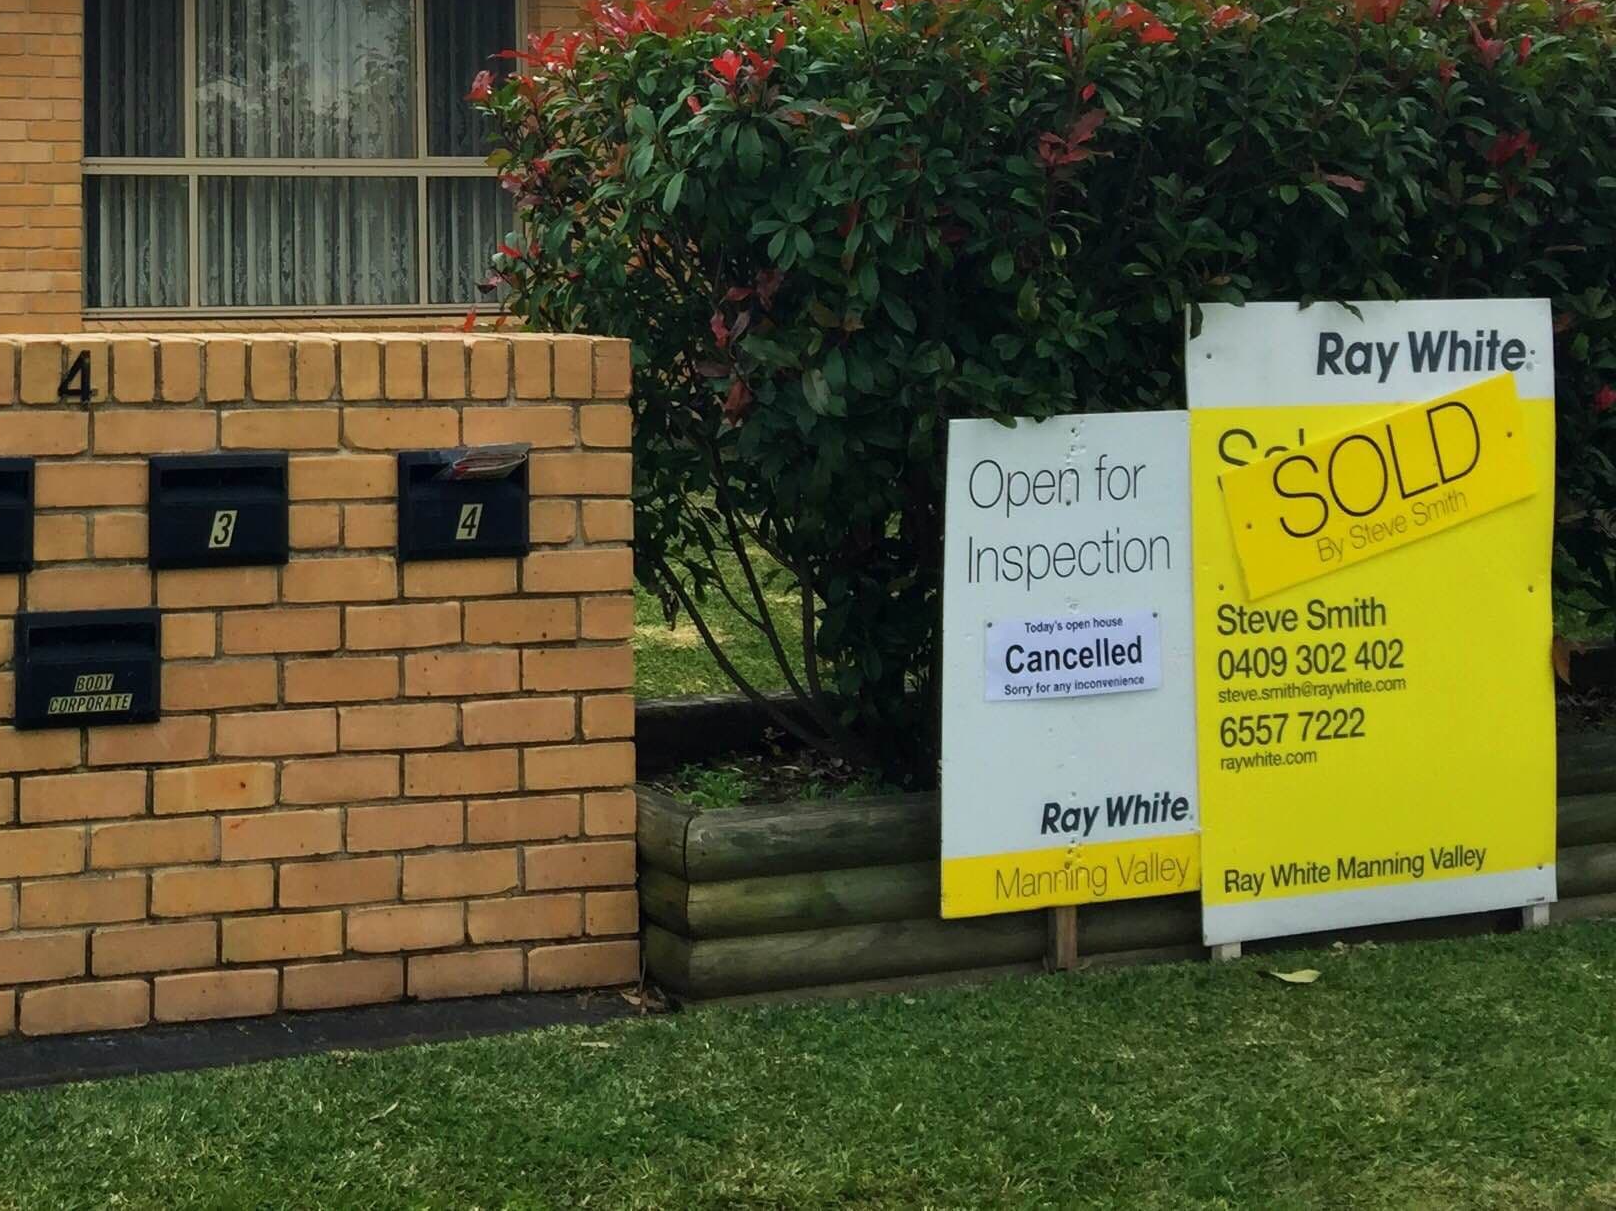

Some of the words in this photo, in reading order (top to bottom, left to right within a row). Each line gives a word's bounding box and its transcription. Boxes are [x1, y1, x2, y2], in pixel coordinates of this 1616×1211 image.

[1316, 331, 1399, 383] Ray
[1407, 329, 1527, 373] White
[57, 350, 98, 411] 4
[969, 459, 1080, 518] Open
[1095, 454, 1146, 501] for
[1272, 401, 1481, 539] SOLD
[213, 513, 233, 545] 3
[461, 506, 478, 537] 4
[1315, 535, 1345, 562] By
[1348, 513, 1409, 551] Steve
[1410, 489, 1469, 528] Smith
[968, 527, 1171, 592] Inspection
[1024, 620, 1064, 635] Today's
[1065, 619, 1090, 634] open
[1092, 616, 1123, 630] house
[1217, 604, 1299, 636] Steve
[1306, 596, 1387, 631] Smith
[1005, 635, 1143, 674] Cancelled
[1217, 646, 1288, 681] 0409
[1295, 642, 1347, 675] 302
[1354, 638, 1404, 671] 402
[49, 694, 129, 713] CORPORATE
[77, 675, 113, 692] BODY
[1004, 683, 1034, 697] Sorry
[1036, 681, 1052, 694] for
[1053, 682, 1072, 695] any
[1074, 675, 1145, 691] inconvenience
[1218, 677, 1406, 704] steve.smith@raywhite.com
[1220, 713, 1289, 748] 6557
[1297, 707, 1366, 742] 7222
[1220, 750, 1317, 774] raywhite.com
[1040, 801, 1100, 837] Ray
[1106, 791, 1189, 828] White
[995, 863, 1108, 900] Manning
[1116, 853, 1191, 888] Valley
[1224, 869, 1265, 897] Ray
[1271, 861, 1331, 888] White
[1337, 851, 1425, 881] Manning
[1430, 844, 1487, 871] Valley
